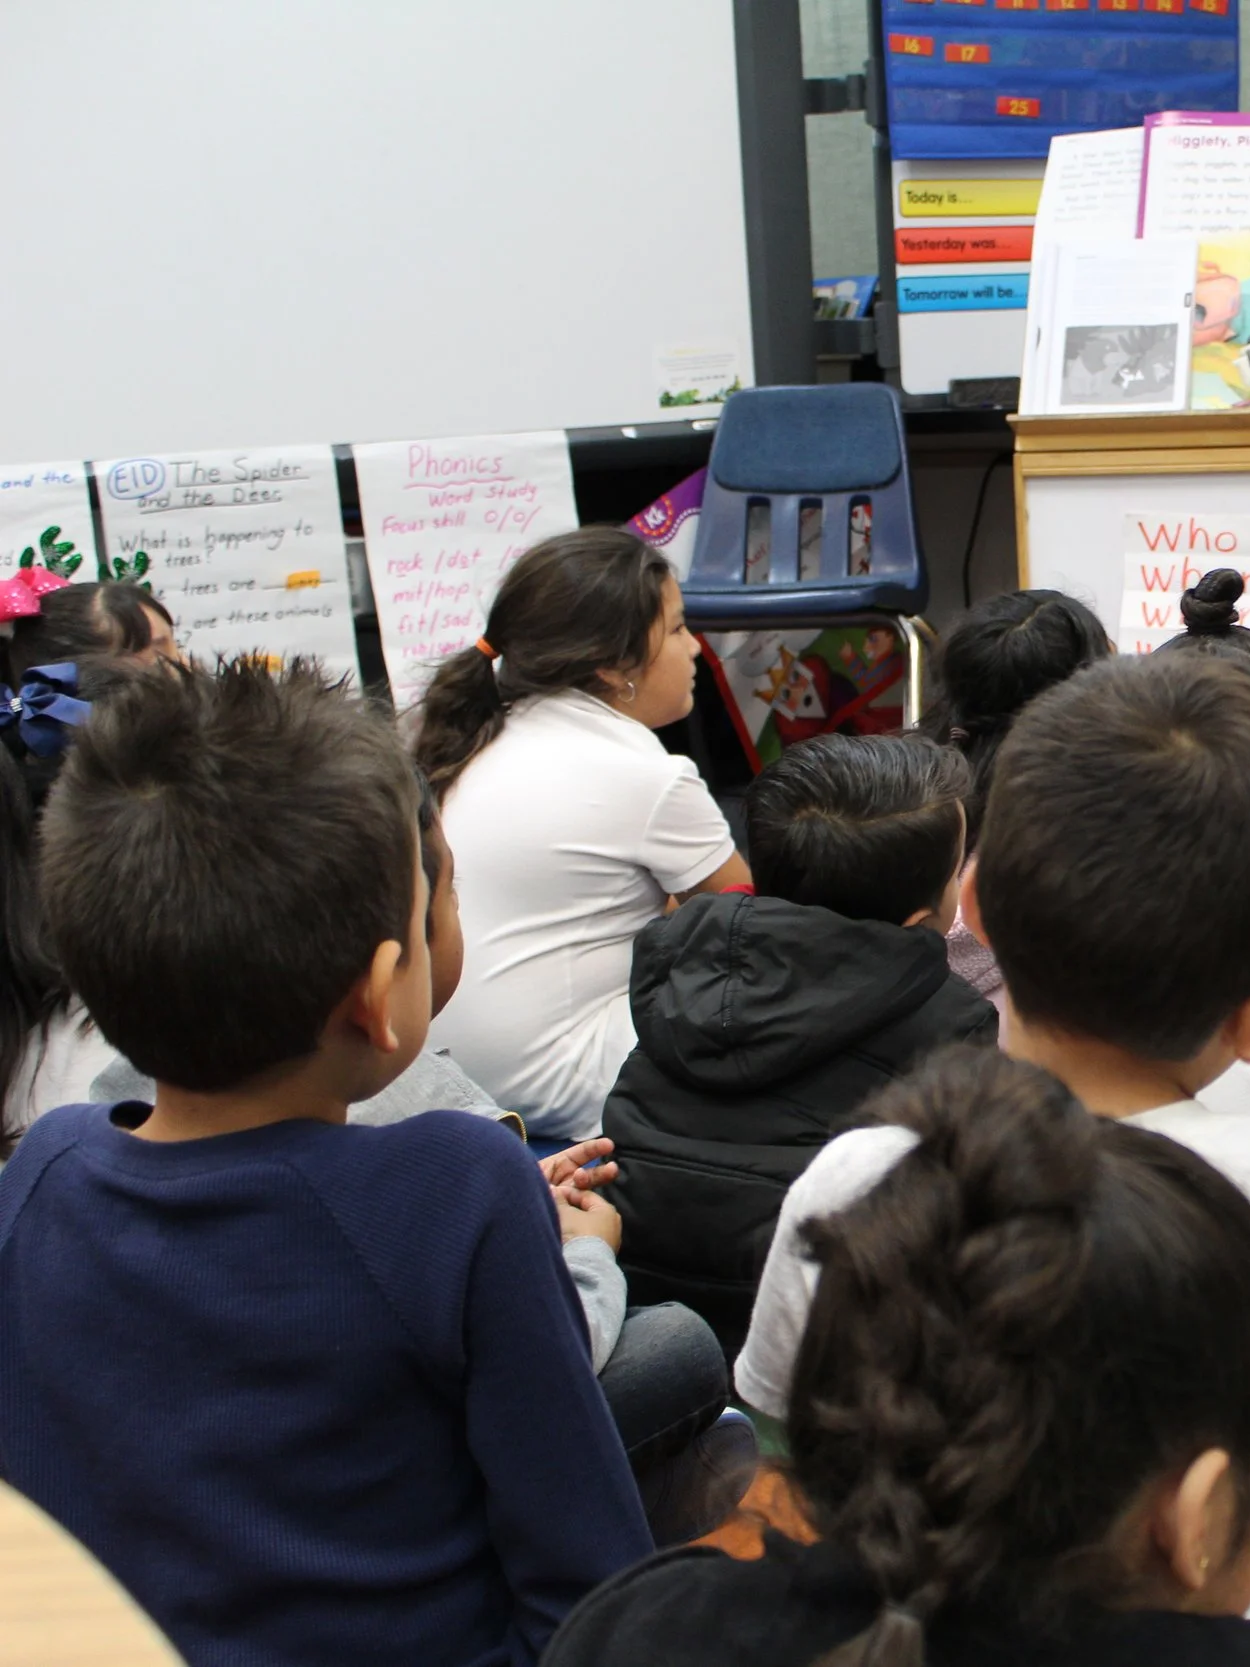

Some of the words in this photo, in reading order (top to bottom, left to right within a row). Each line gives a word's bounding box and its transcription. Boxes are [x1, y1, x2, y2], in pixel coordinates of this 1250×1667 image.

[904, 39, 920, 54] 16
[961, 46, 976, 61] 17
[1009, 101, 1028, 116] 25
[906, 190, 943, 207] Today
[901, 238, 965, 253] Yesterday
[903, 287, 968, 302] Tomorrow
[970, 285, 994, 299] will
[168, 460, 221, 484] The
[233, 457, 301, 488] Spider
[407, 445, 502, 480] Phonics
[41, 469, 75, 485] the
[182, 487, 215, 507] the
[429, 489, 475, 507] Word
[484, 481, 537, 503] Study
[382, 513, 425, 537] Focus
[1138, 516, 1238, 552] Who
[119, 528, 167, 553] What
[178, 536, 191, 549] is
[205, 526, 285, 551] happening
[293, 519, 313, 537] to
[165, 545, 215, 567] trees?
[181, 578, 219, 596] trees
[228, 579, 257, 592] are
[193, 617, 217, 630] are
[228, 609, 270, 625] these
